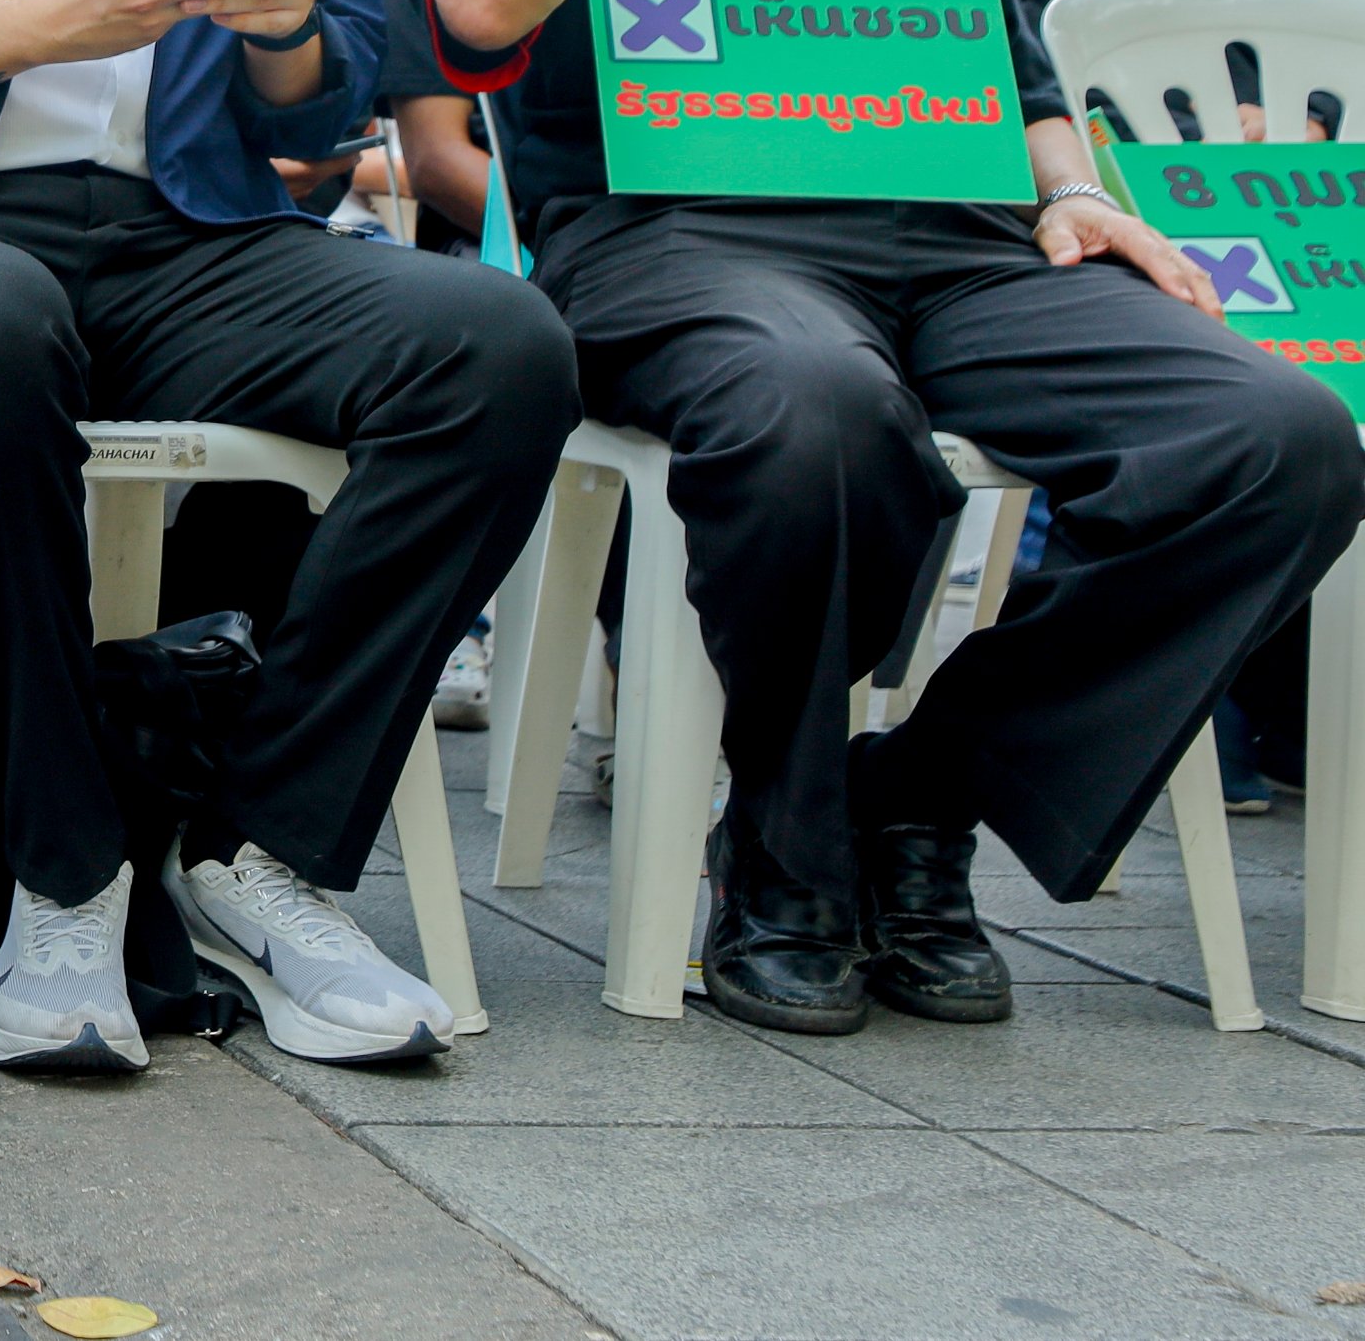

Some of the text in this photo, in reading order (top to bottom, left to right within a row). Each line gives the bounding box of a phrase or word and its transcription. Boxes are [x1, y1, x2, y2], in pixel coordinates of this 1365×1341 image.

[615, 80, 1002, 133] รัฐธรรมนูญใหม่
[1162, 164, 1218, 208] 8
